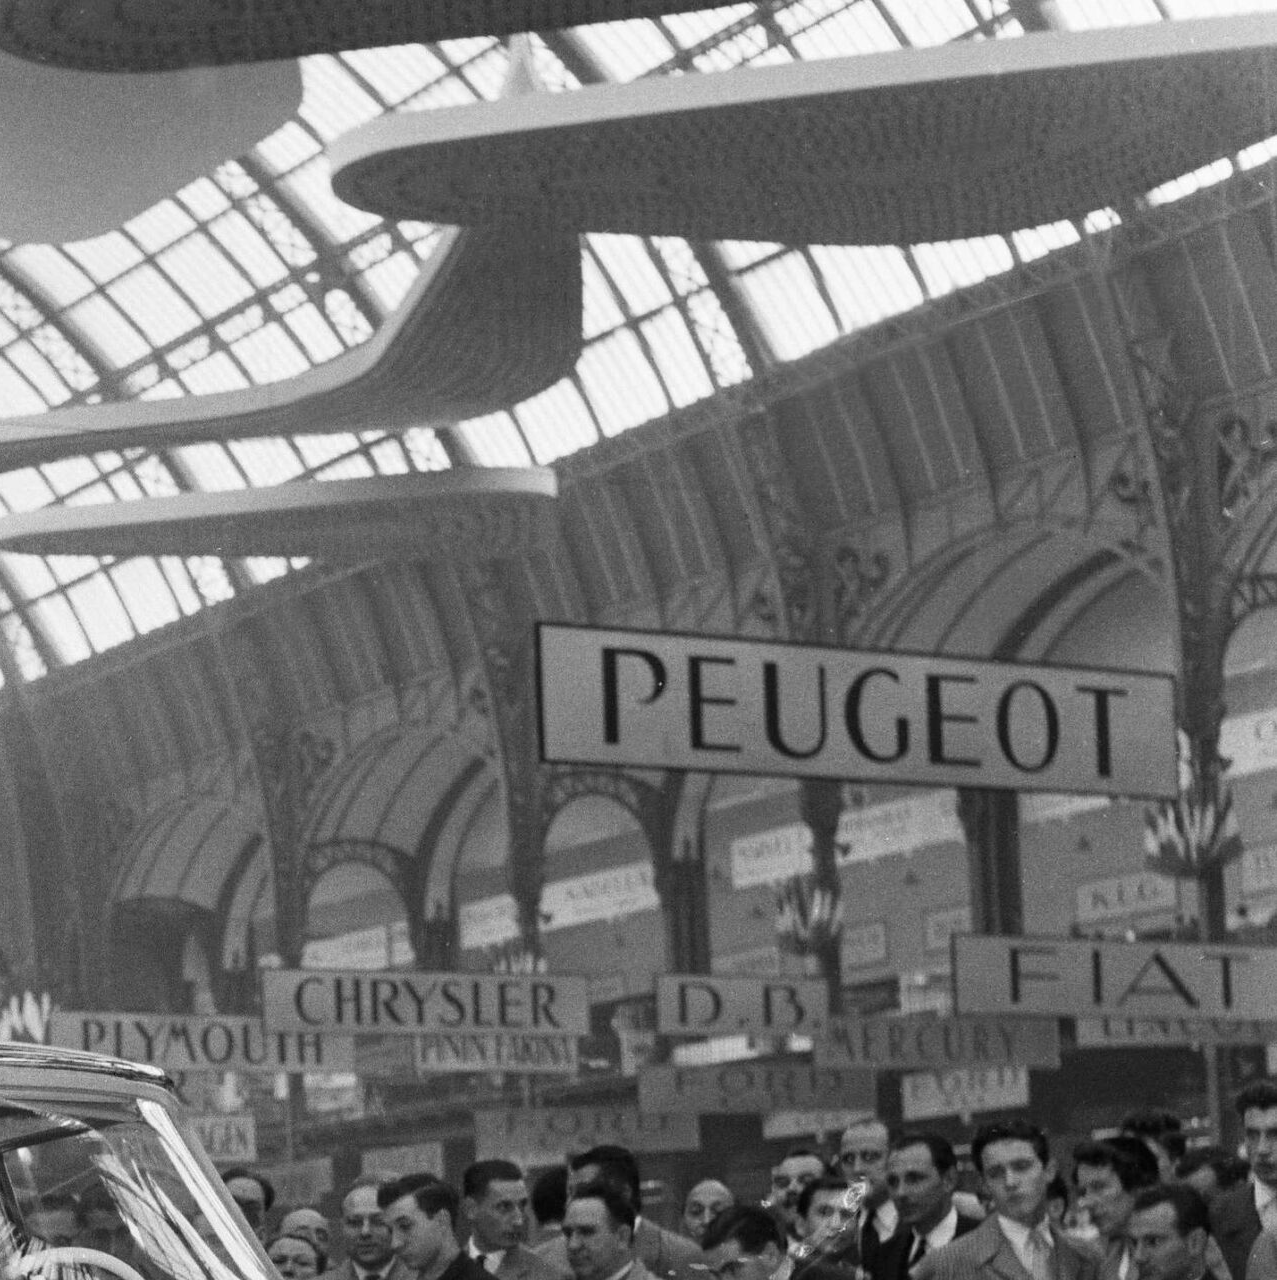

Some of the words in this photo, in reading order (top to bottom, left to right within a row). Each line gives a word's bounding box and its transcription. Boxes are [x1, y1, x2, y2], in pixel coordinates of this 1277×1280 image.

[602, 647, 1128, 778] PEUGEOT
[294, 977, 560, 1028] CHRYSLER
[1008, 946, 1253, 1008] FIAT
[82, 1017, 323, 1065] PLYMOUTH
[827, 1021, 1014, 1064] MERCURY
